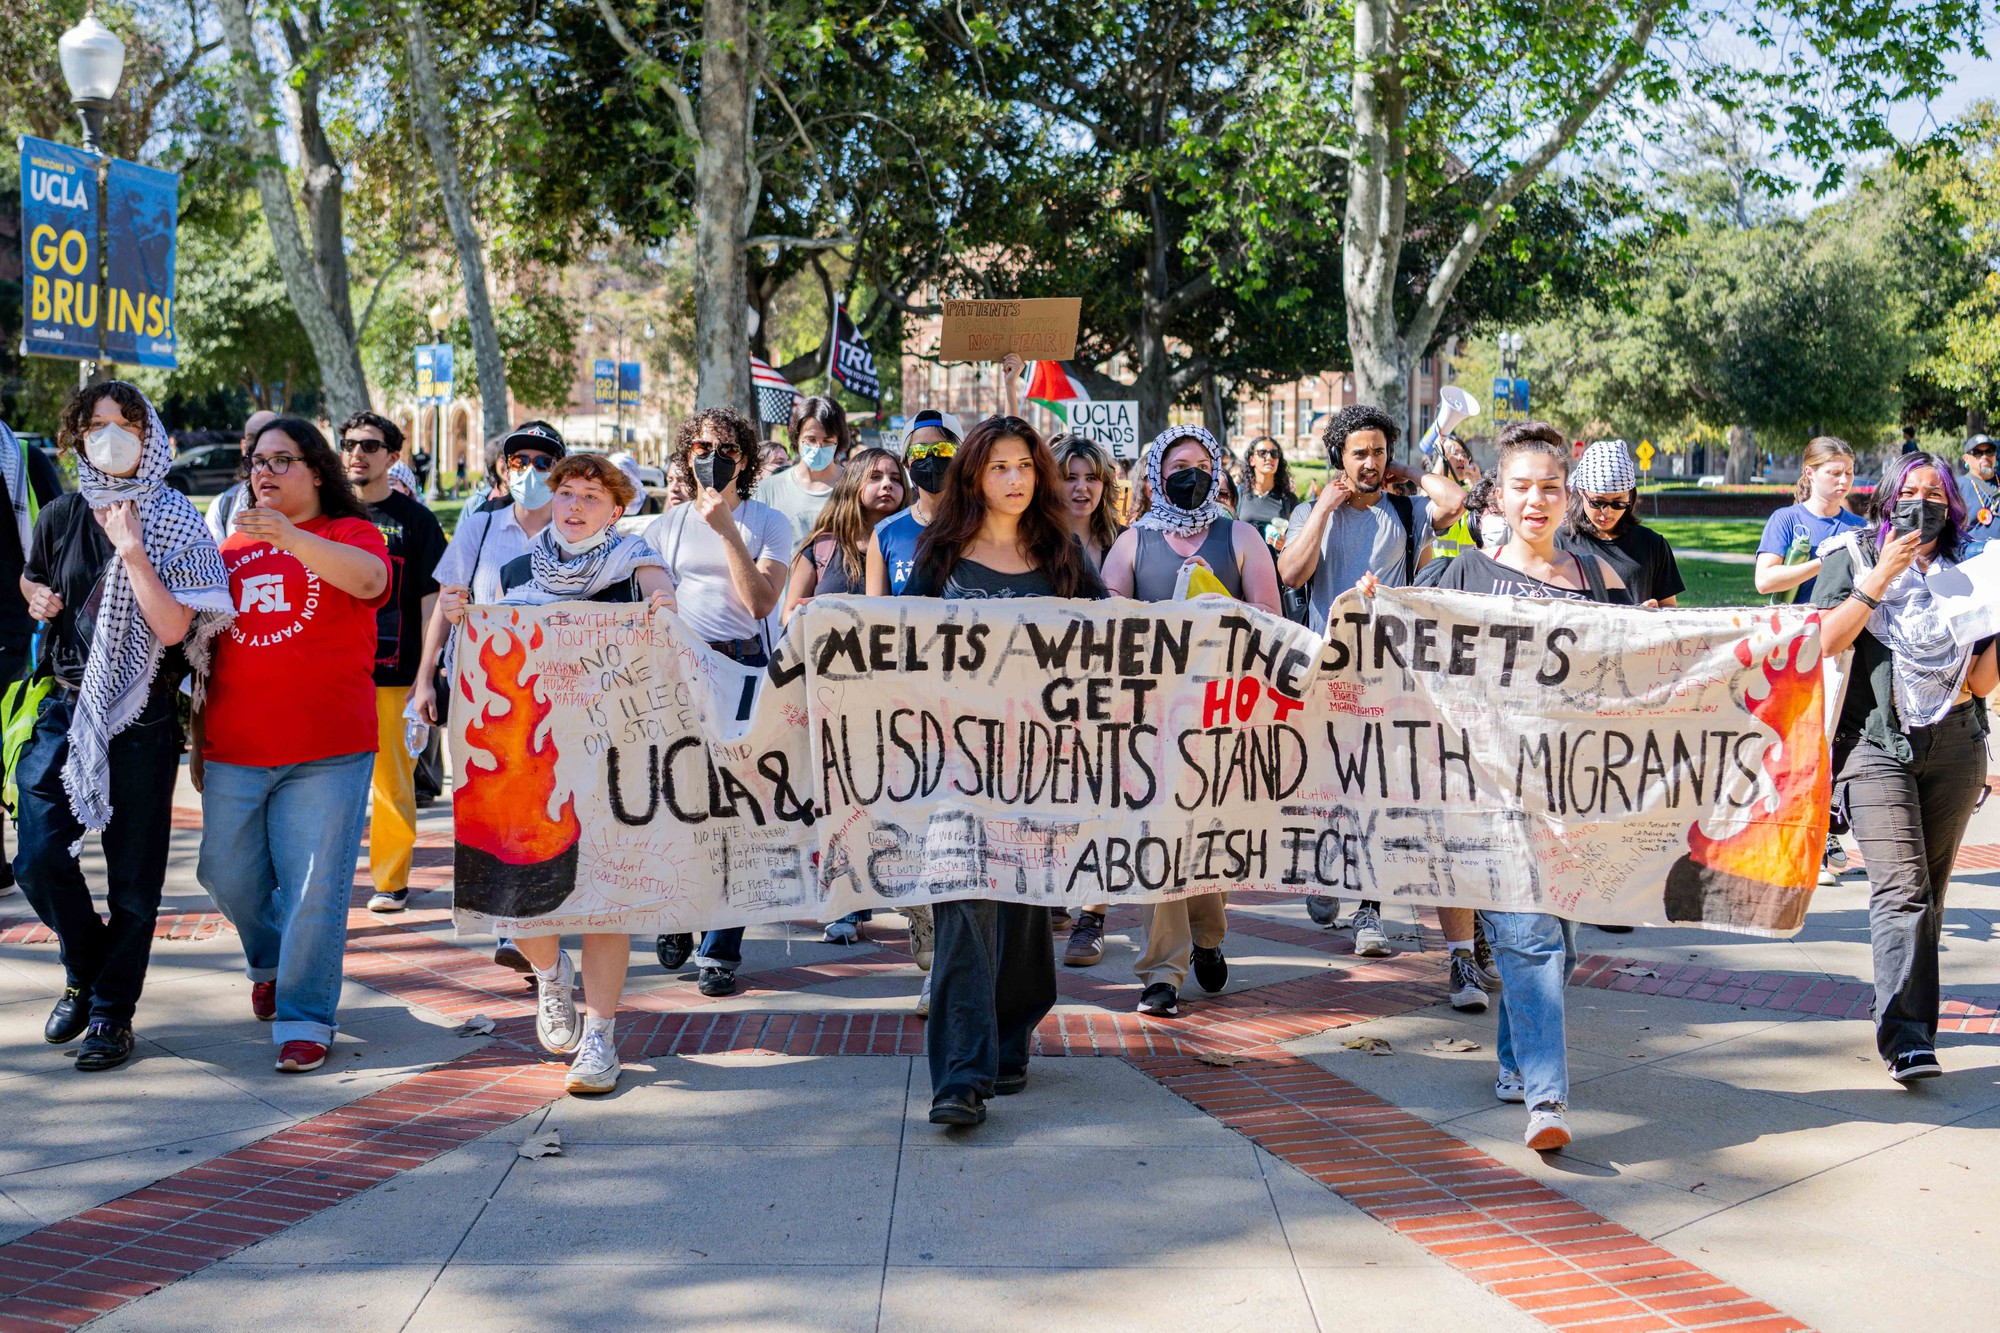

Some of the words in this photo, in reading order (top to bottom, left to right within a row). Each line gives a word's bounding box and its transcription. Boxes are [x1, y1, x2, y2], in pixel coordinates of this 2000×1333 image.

[30, 169, 89, 211] UCLA
[30, 223, 88, 276] GO
[946, 301, 1020, 317] PATIENTS
[969, 333, 1004, 351] NOT
[1009, 332, 1068, 355] FEAR!
[596, 378, 613, 389] GO
[1073, 404, 1130, 426] UCLA
[1495, 397, 1507, 410] GO
[1072, 426, 1134, 444] FUNDS
[239, 583, 291, 613] PSL
[574, 611, 616, 627] WITH
[626, 612, 656, 627] THE
[249, 620, 304, 647] PARTY
[555, 628, 608, 649] YOUTH
[580, 644, 621, 674] NO
[817, 623, 991, 676] MELTS
[1023, 618, 1193, 676] WHEN
[1219, 614, 1312, 699] THE
[1321, 612, 1578, 687] STREETS
[1657, 657, 1683, 675] LA
[601, 654, 652, 692] ONE
[586, 701, 608, 727] IS
[1042, 676, 1158, 725] GET
[1203, 676, 1305, 728] HOT
[584, 730, 613, 756] ON
[607, 735, 767, 827] UCLA
[757, 751, 816, 827] &
[953, 715, 1158, 810] STUDENTS
[1175, 724, 1308, 811] STAND
[1327, 720, 1477, 801] WITH
[1516, 728, 1763, 816] MIGRANTS
[694, 831, 709, 845] NO
[713, 825, 746, 840] HATE!
[986, 821, 1075, 845] STRONGER
[1066, 829, 1268, 893] ABOLISH
[1281, 827, 1362, 891] ICE
[594, 869, 675, 900] SOLIDARITY!
